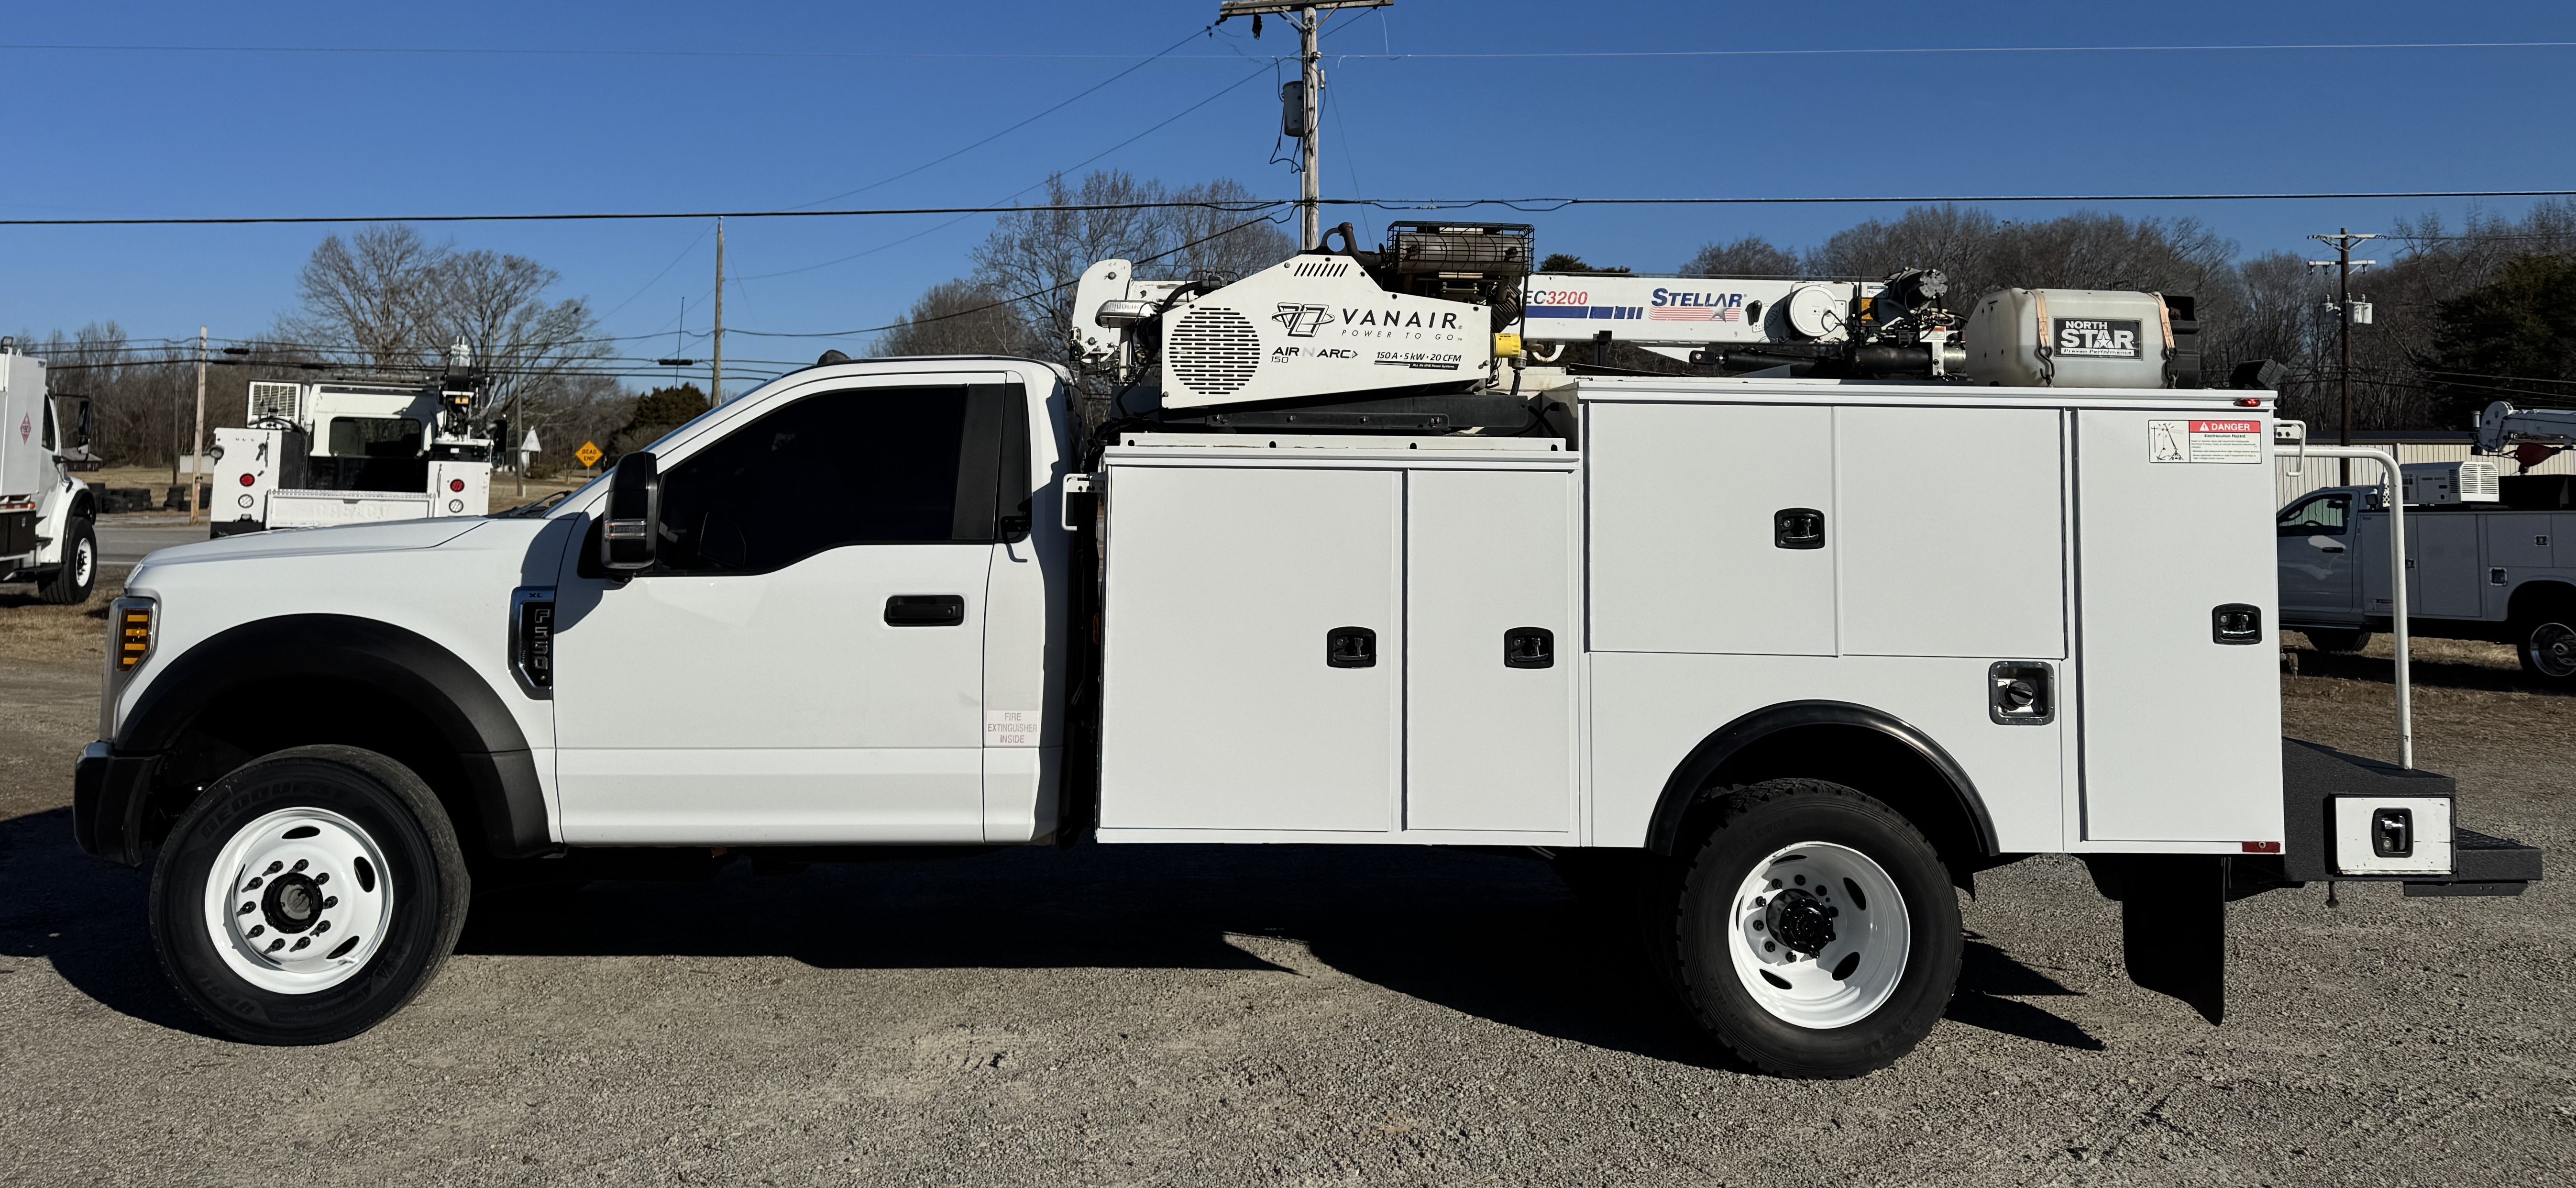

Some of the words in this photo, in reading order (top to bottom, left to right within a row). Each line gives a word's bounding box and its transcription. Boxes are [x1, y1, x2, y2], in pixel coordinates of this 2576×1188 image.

[1651, 288, 1743, 307] STELLAR
[1343, 308, 1457, 329] VANAIR
[2066, 321, 2108, 330] NORTH
[1342, 329, 1392, 338] POWER
[2060, 328, 2134, 349] STAR
[1272, 346, 1299, 356] AIR
[1302, 347, 1315, 357] N
[1410, 352, 1425, 360] kW
[1005, 712, 1022, 721] FIRE
[988, 723, 1037, 733] EXTINGUISHER
[1000, 735, 1024, 743] INSIDE
